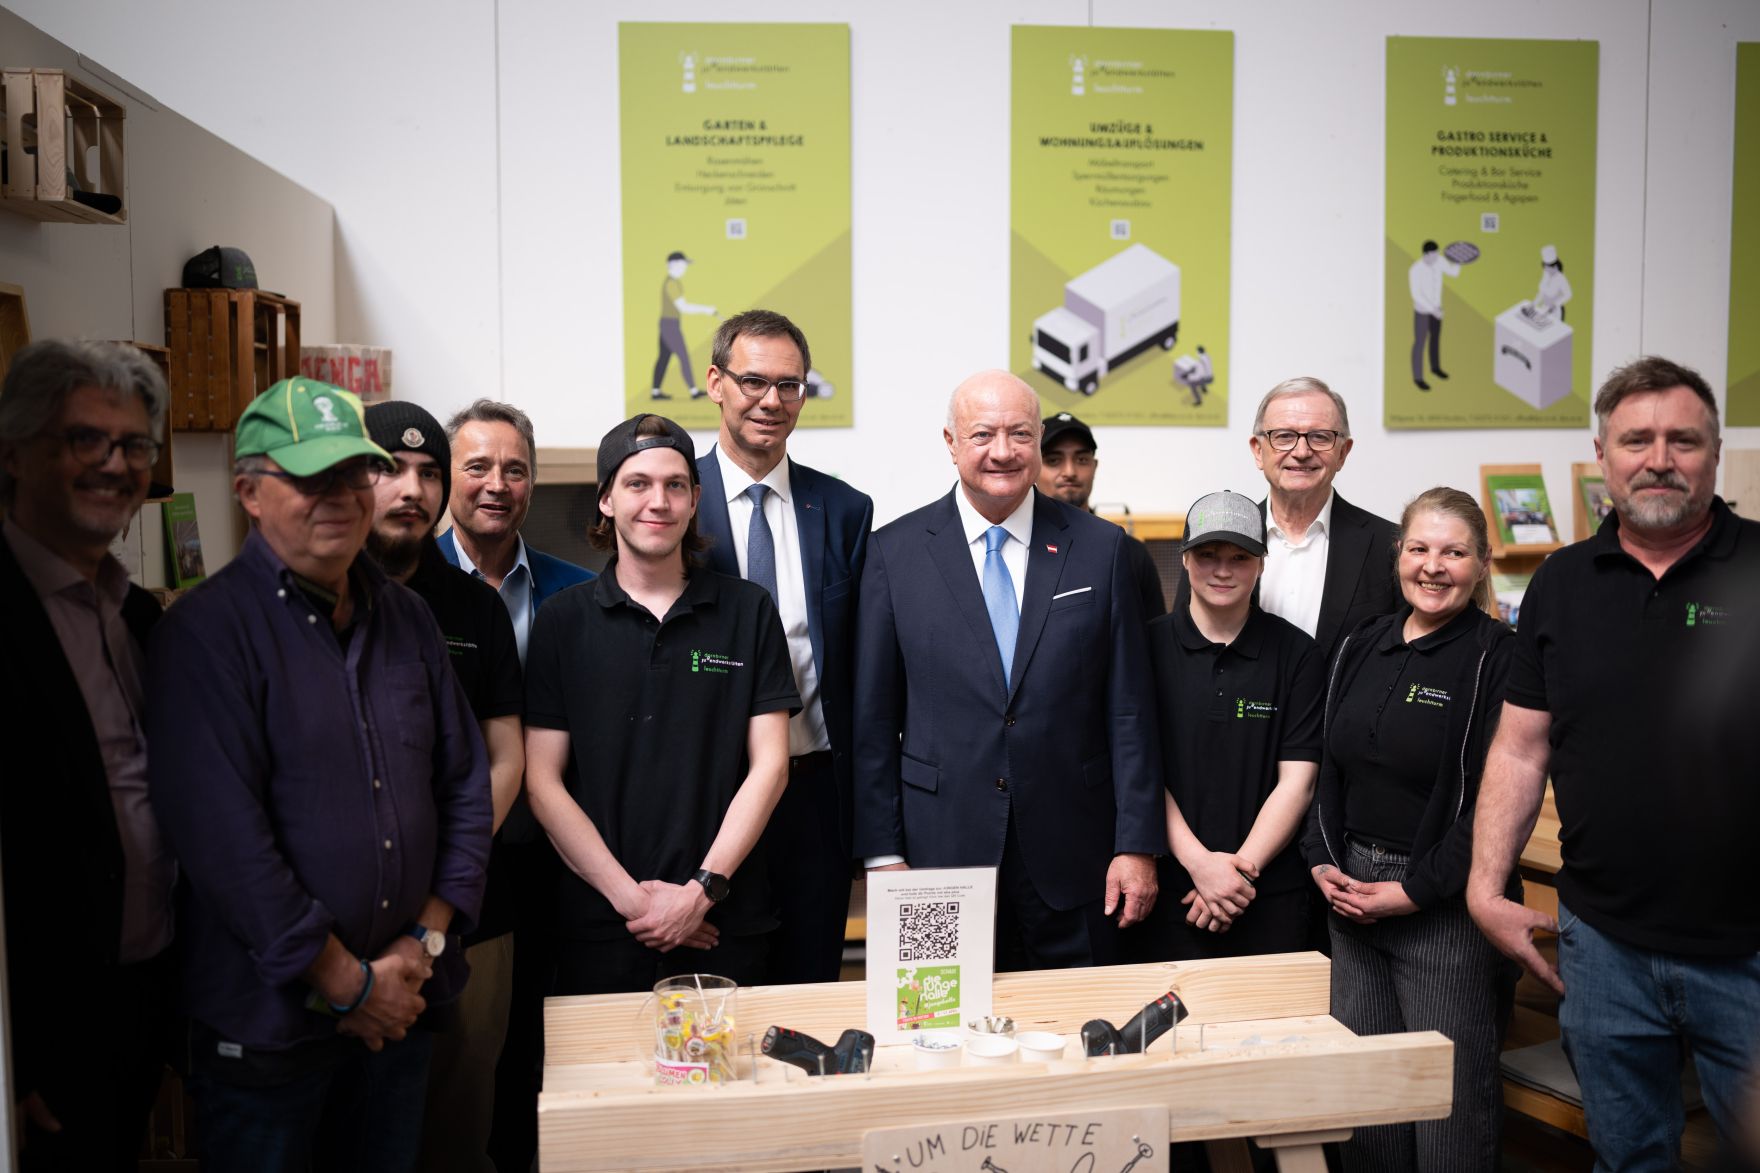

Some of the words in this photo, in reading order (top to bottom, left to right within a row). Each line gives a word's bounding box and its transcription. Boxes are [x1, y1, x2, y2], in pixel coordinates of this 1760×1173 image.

[703, 120, 755, 130] GARTEN
[759, 120, 767, 130] &
[1090, 120, 1141, 134] UMZÜGE
[1145, 124, 1153, 134] &
[666, 135, 804, 146] LANDSCHAFTSPFLEGE
[1039, 136, 1204, 150] WOHNUNGSAUFLÖSUNGEN
[1437, 131, 1485, 142] GASTRO
[1489, 132, 1536, 143] SERVICE
[1540, 133, 1548, 144] &
[1431, 144, 1553, 158] PRODUKTIONSKÜCHE
[1438, 165, 1478, 177] Catering
[1481, 166, 1488, 175] &
[1491, 166, 1506, 176] Bar
[1509, 166, 1542, 177] Service
[1452, 179, 1529, 190] Produktionsküche
[1441, 191, 1490, 204] Fingerfood
[1493, 192, 1500, 202] &
[923, 975, 941, 984] die
[906, 1134, 946, 1168] UM
[1013, 1122, 1102, 1146] WETTE
